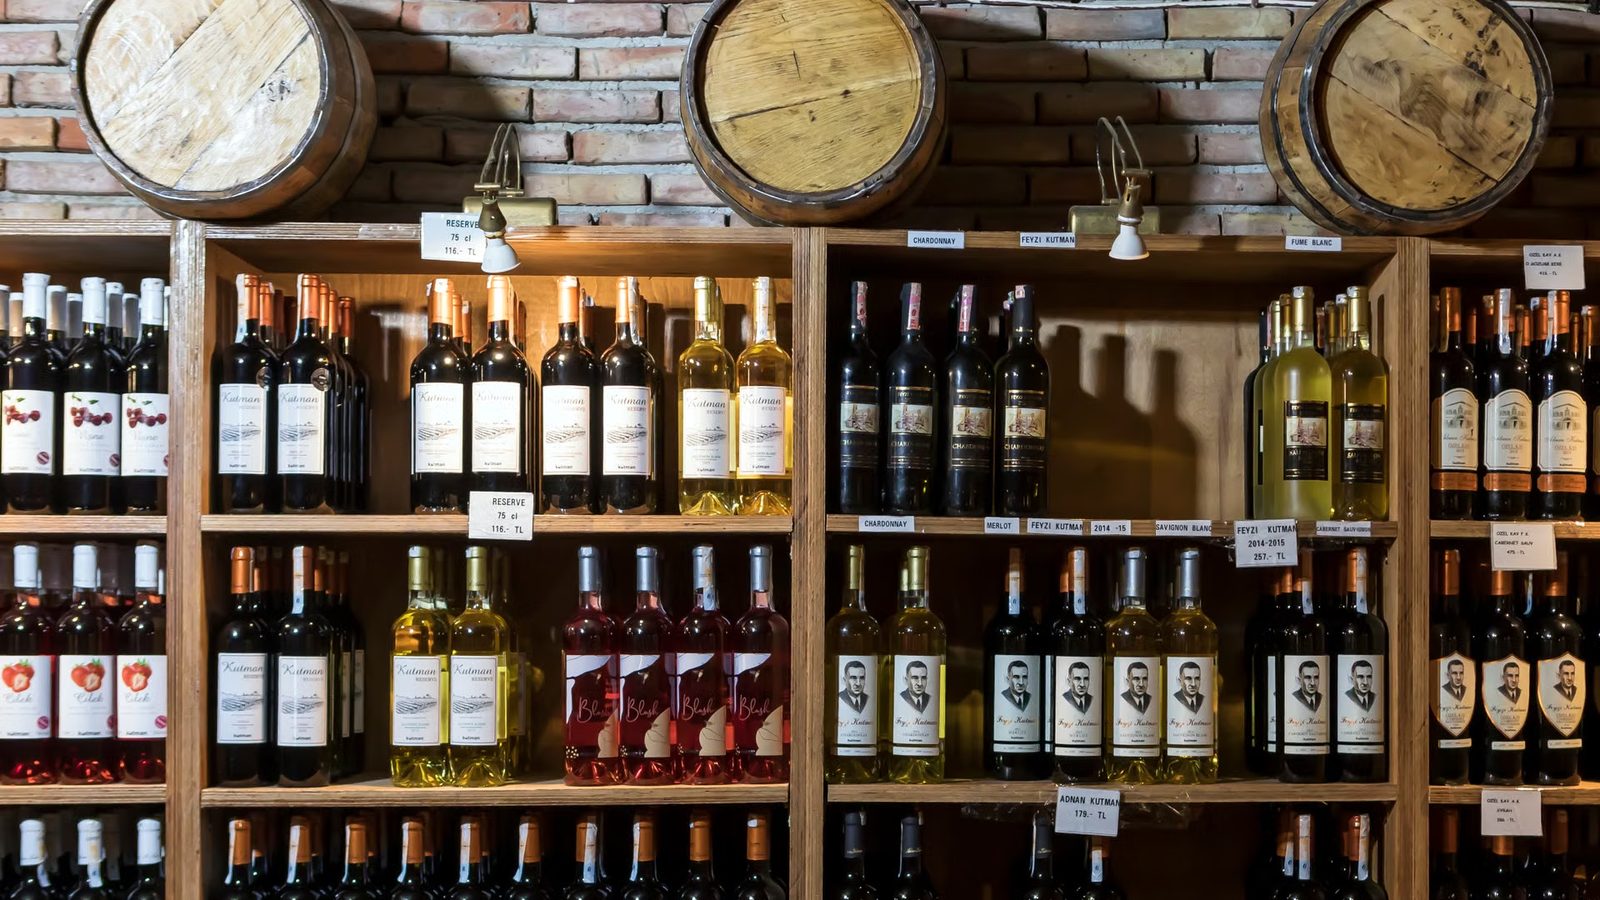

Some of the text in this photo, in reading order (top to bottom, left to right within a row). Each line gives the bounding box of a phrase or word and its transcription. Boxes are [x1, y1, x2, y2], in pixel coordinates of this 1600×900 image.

[446, 220, 479, 228] RESERVE
[913, 237, 956, 245] CHARDONNAY
[492, 498, 526, 506] RESERVE
[1248, 539, 1285, 547] 2014-2015
[222, 661, 263, 673] Kutman
[282, 664, 323, 675] Kutman
[397, 664, 435, 676] Kutman
[454, 664, 492, 675] Kutman
[1060, 795, 1120, 806] ADNAN KUTMAN
